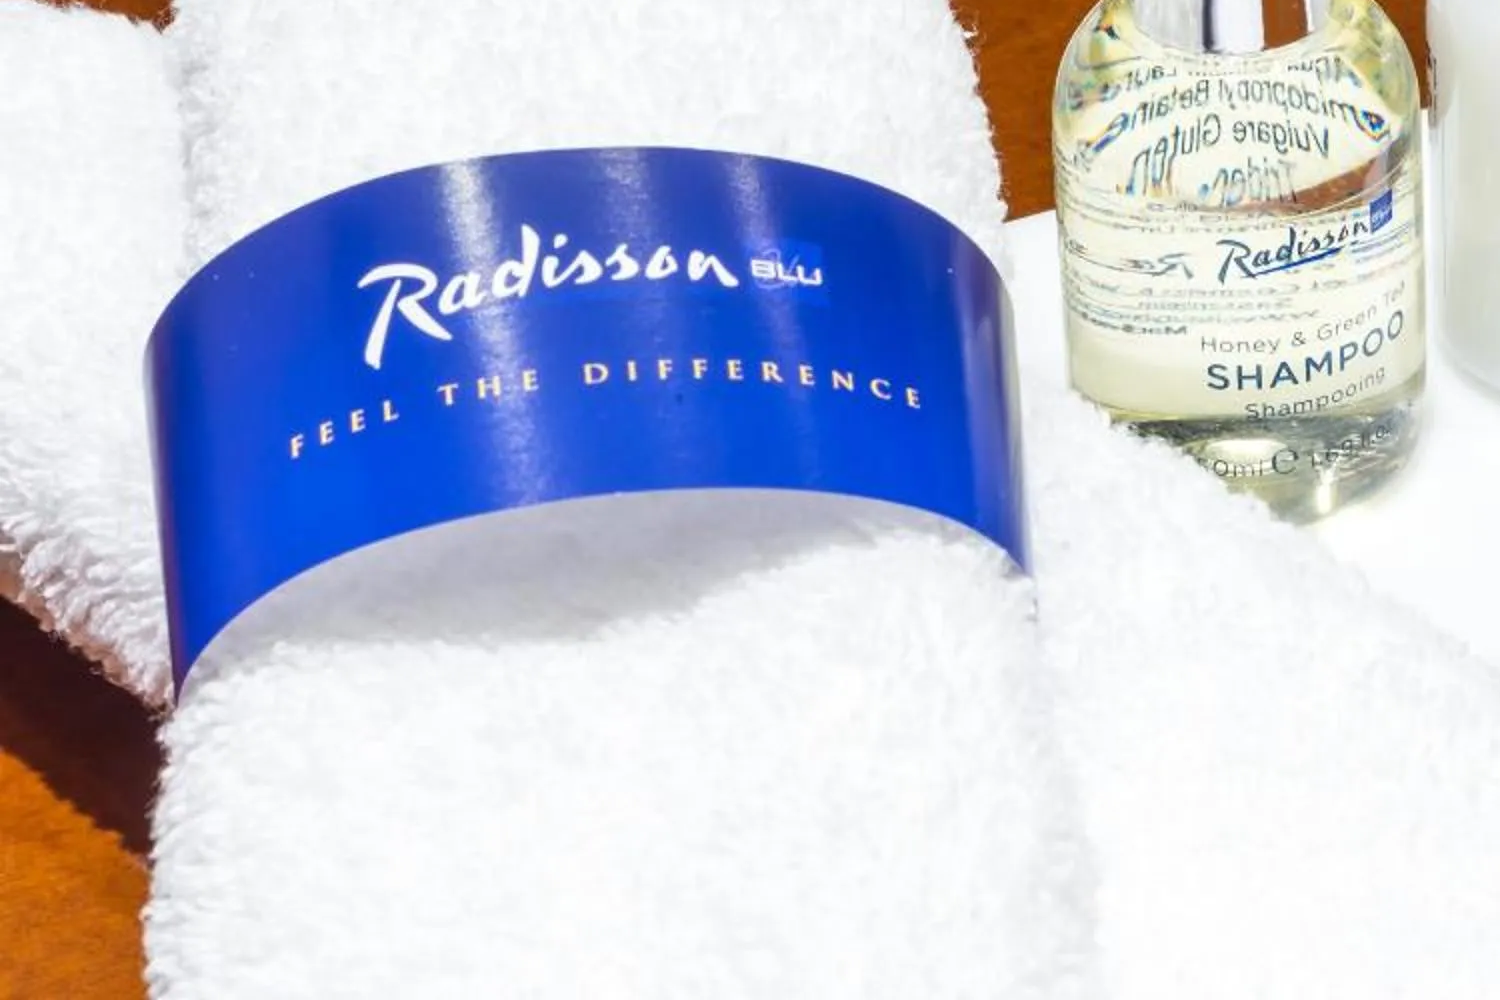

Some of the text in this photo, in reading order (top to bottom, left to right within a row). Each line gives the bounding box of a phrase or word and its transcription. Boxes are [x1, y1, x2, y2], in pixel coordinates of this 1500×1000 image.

[1216, 225, 1369, 286] Radisson
[358, 223, 824, 371] Radisson BLU
[1201, 335, 1281, 355] Honey
[1291, 330, 1307, 348] &
[1317, 303, 1377, 342] Green
[1206, 309, 1405, 392] SHAMPOO
[289, 358, 922, 460] FEEL THE DIFFERENCE
[1244, 366, 1386, 420] Shampooing
